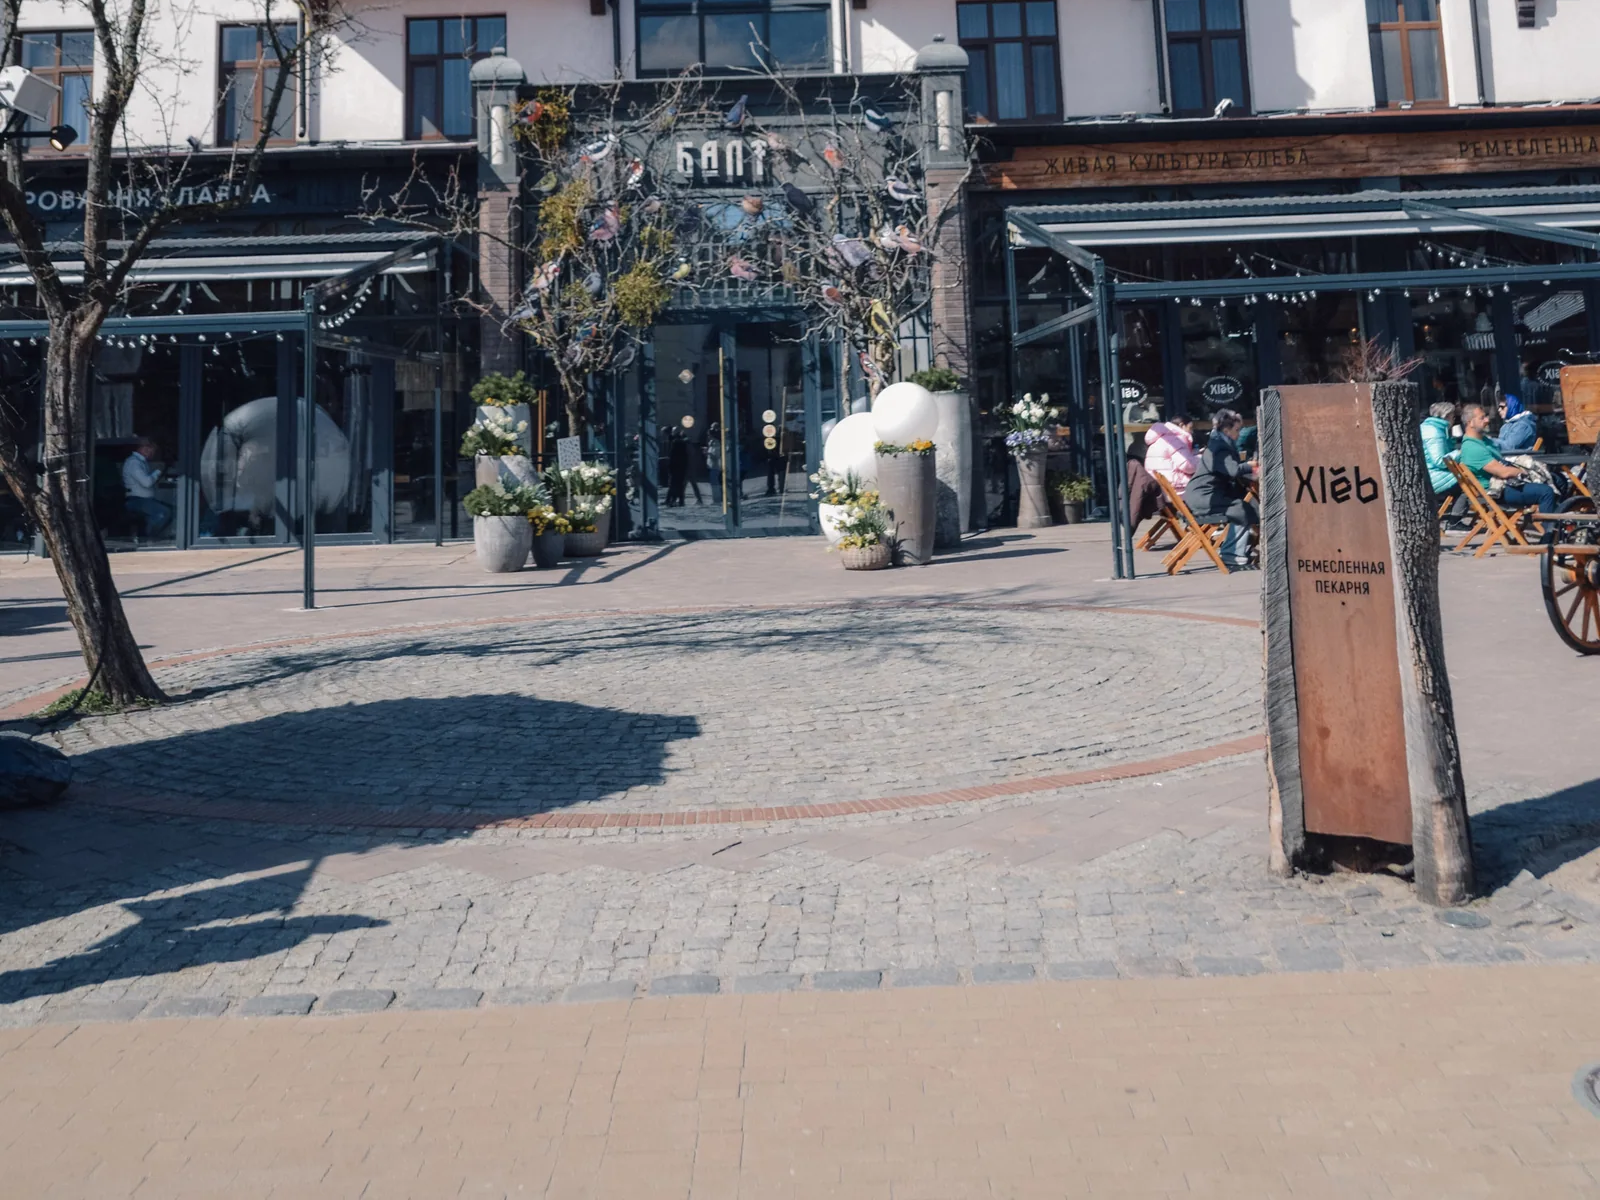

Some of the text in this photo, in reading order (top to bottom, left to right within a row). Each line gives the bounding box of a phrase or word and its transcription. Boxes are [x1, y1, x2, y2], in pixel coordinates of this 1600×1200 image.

[1044, 148, 1309, 174] ЖИВАЯ КУЛЬТУРА ХЛЕБА
[1297, 559, 1386, 575] РЕМЕСЛЕННАЯ
[1315, 580, 1370, 595] ПЕКАРНЯ
